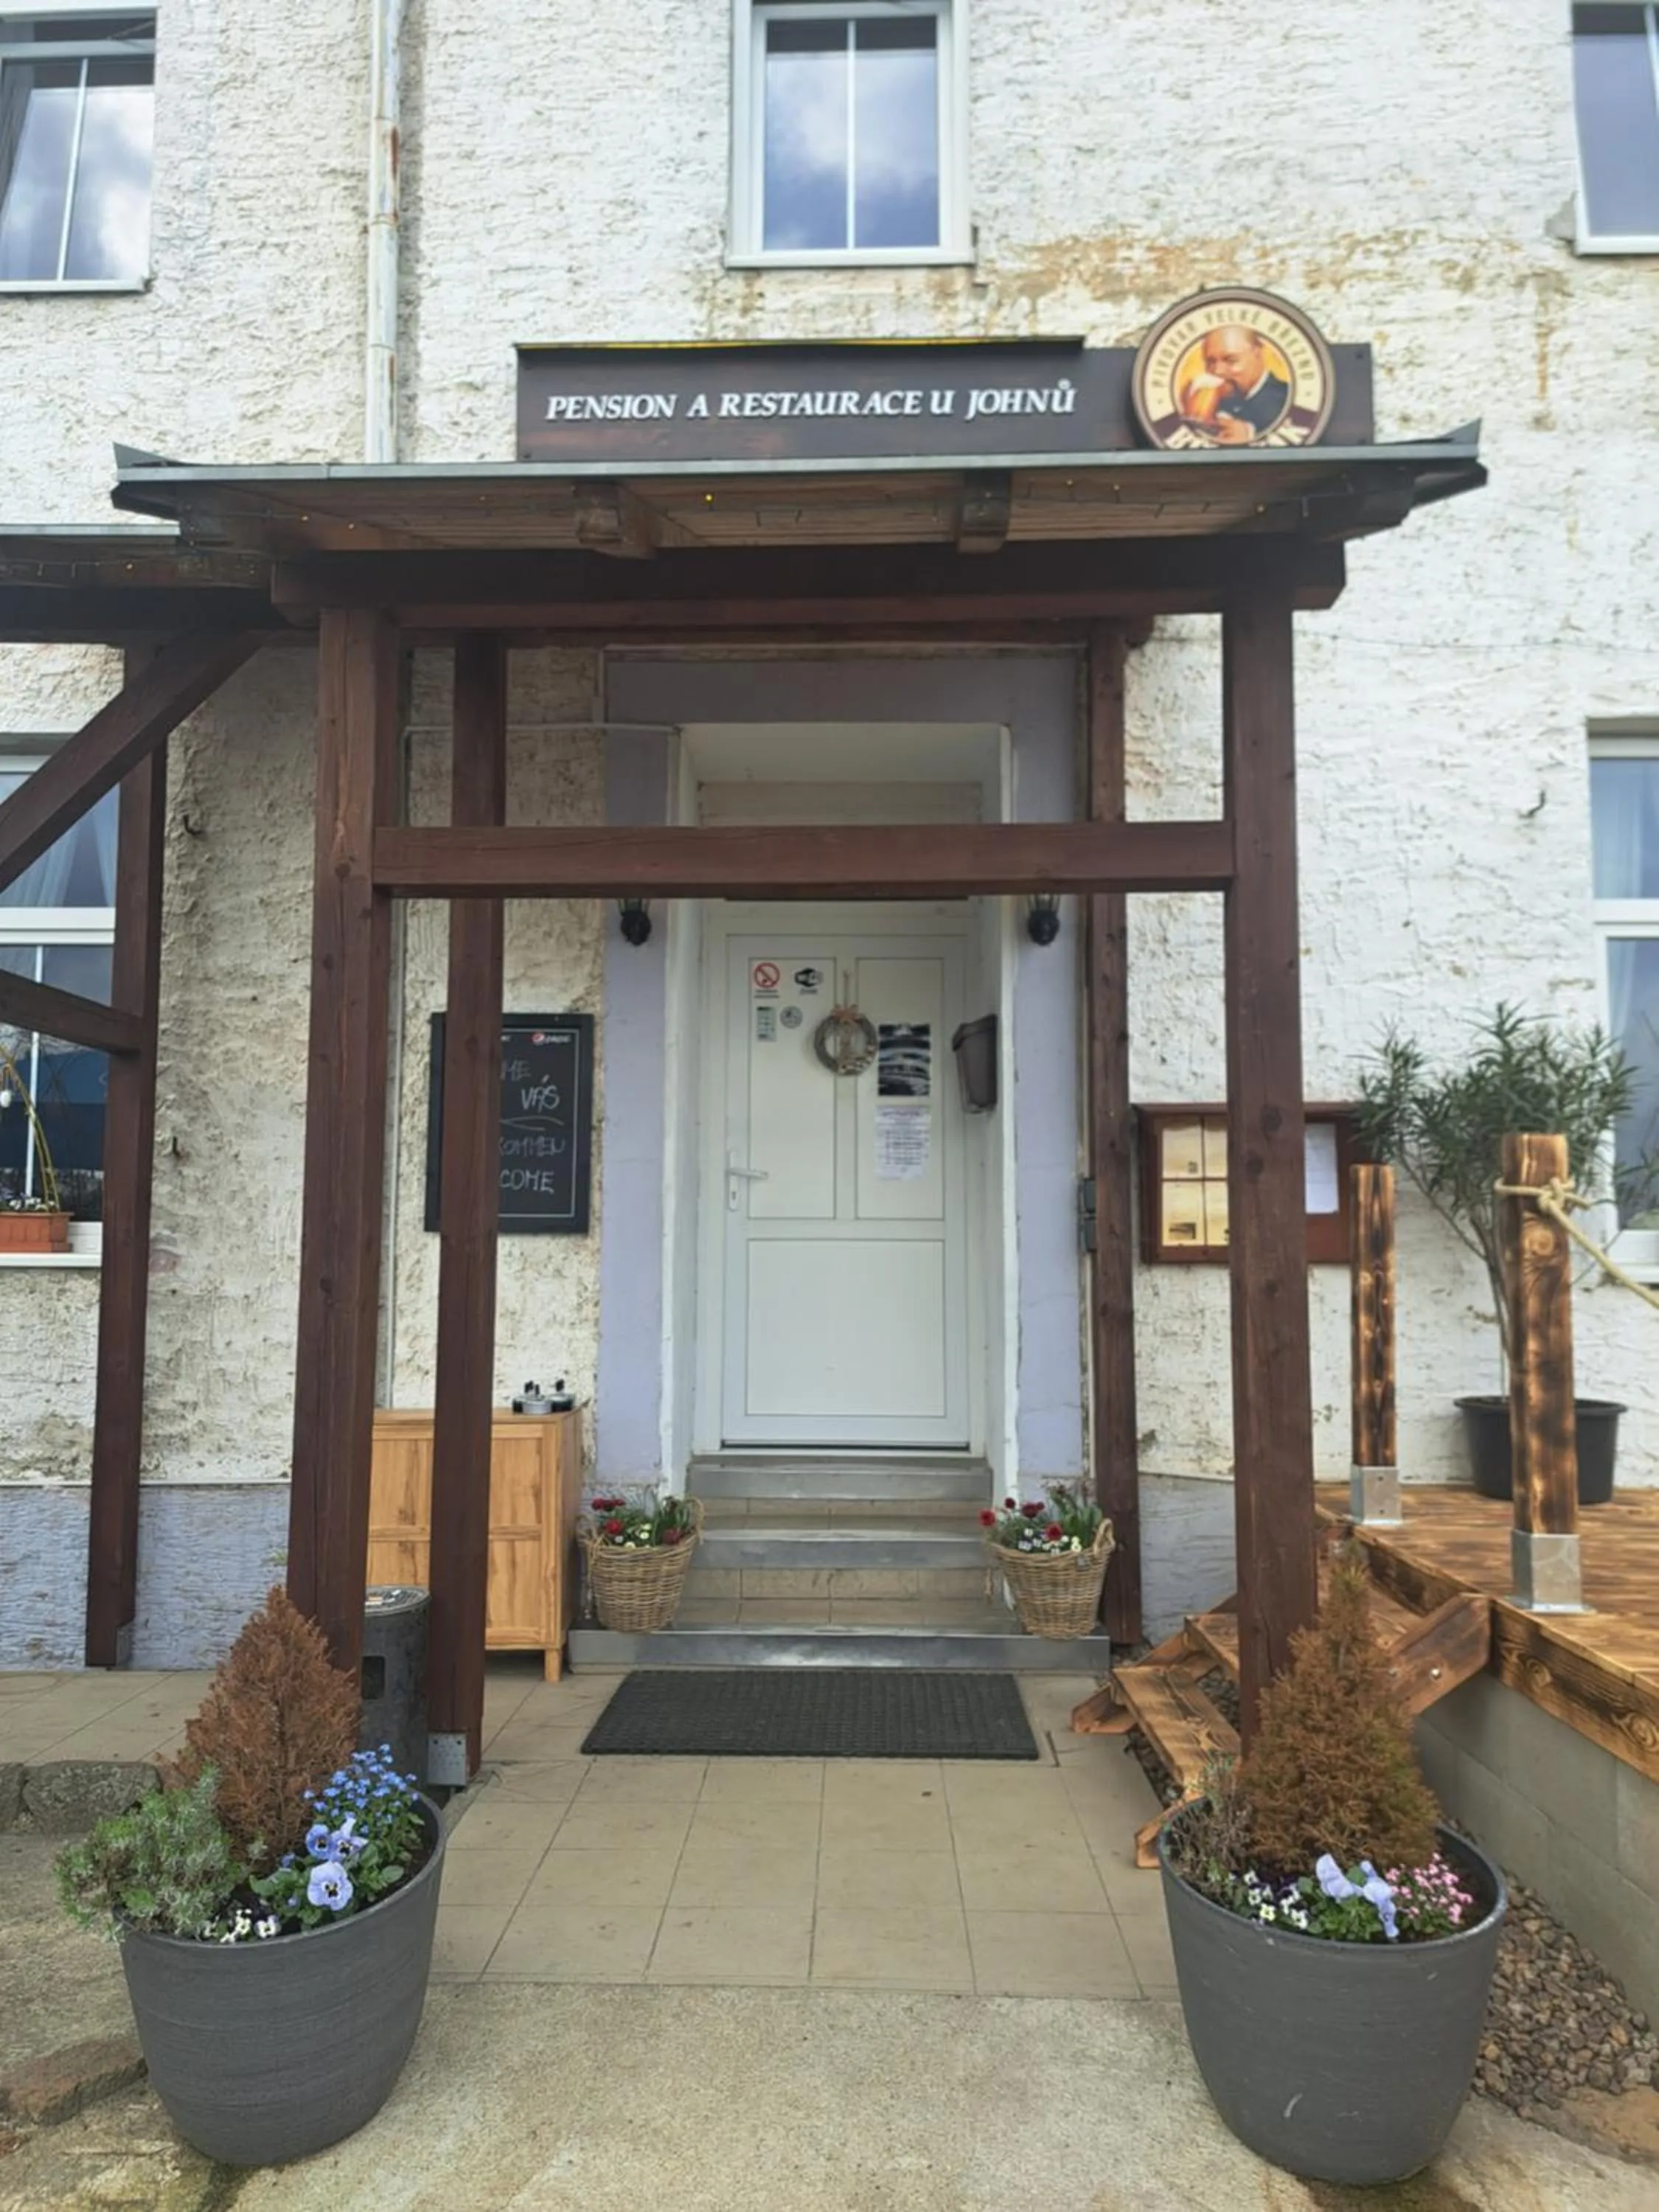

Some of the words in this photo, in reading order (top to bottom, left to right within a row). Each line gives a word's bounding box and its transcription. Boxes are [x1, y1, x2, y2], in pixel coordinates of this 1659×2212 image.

[546, 394, 678, 421] PENSION
[686, 394, 710, 418] A
[717, 390, 924, 418] RESTAURACE
[929, 389, 956, 415] U
[964, 378, 1078, 422] JOHNŮ
[521, 1074, 560, 1113] VÁS
[498, 1168, 555, 1194] COME
